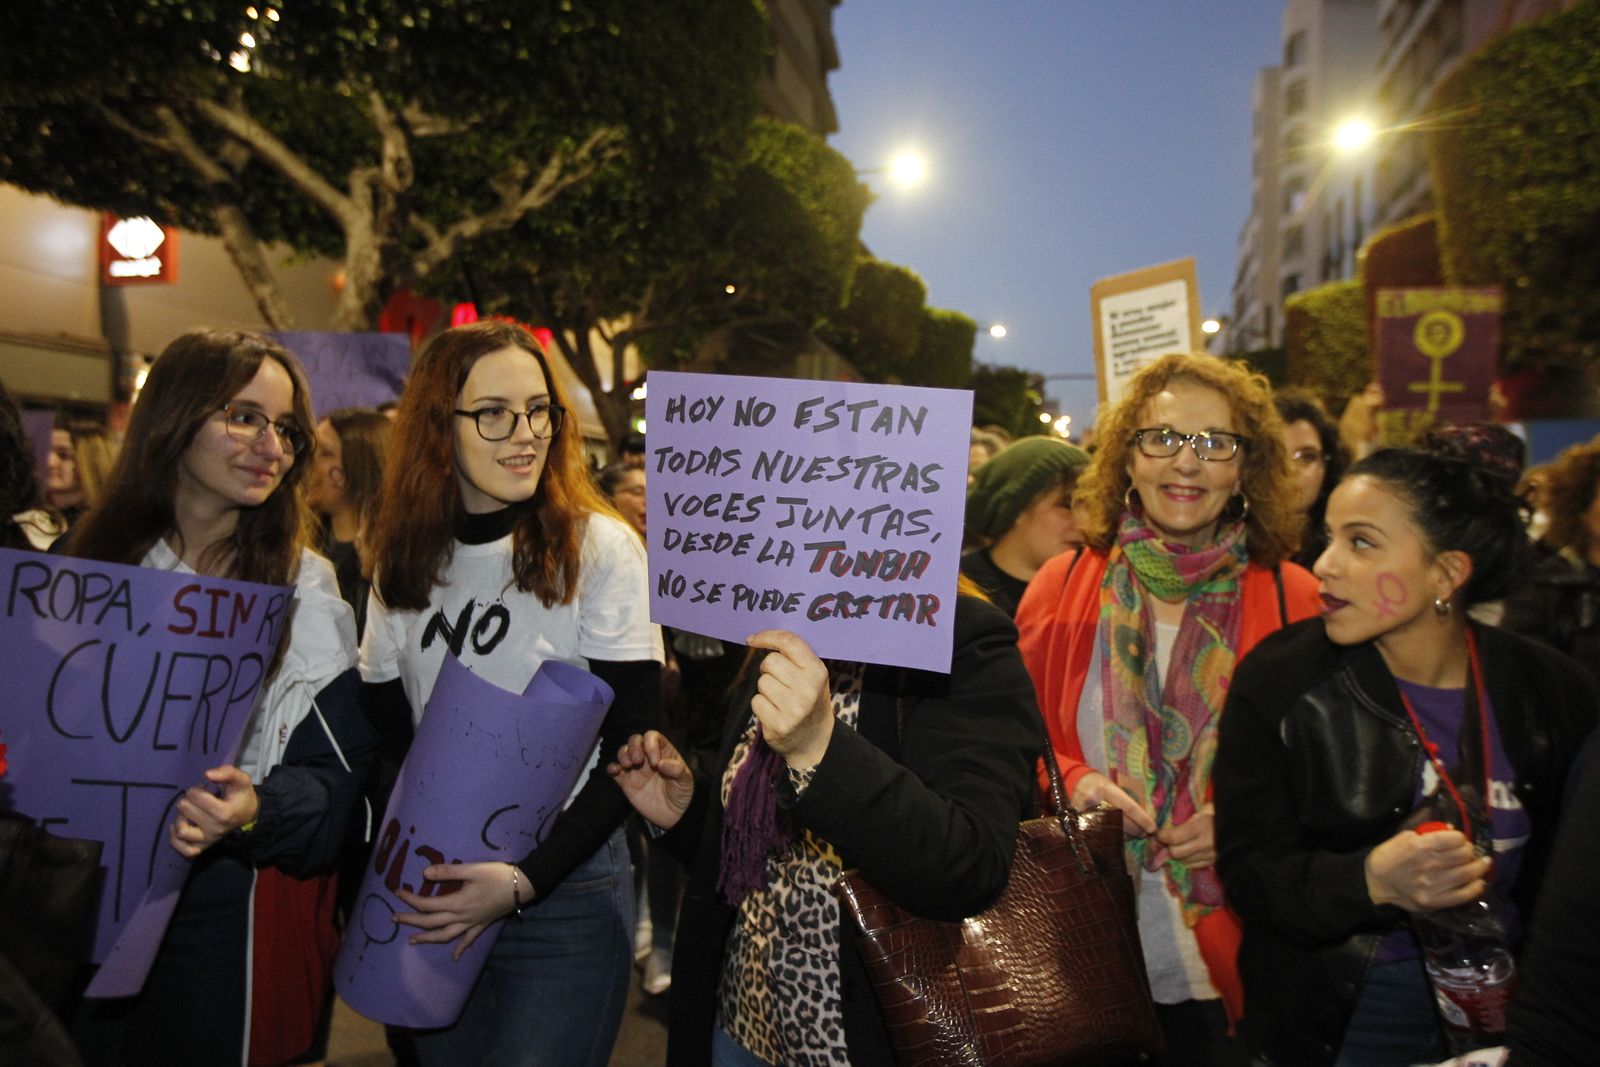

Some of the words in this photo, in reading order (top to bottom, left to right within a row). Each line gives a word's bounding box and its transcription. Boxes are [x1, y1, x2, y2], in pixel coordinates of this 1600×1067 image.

[665, 394, 725, 424] HOY
[733, 396, 776, 427] NO
[793, 396, 928, 437] ESTAN
[654, 446, 743, 477] TODAS
[751, 449, 944, 493] NUESTRAS
[663, 492, 766, 523] VOCES
[775, 496, 942, 544] JUNTAS,
[663, 527, 755, 557] DESDE
[756, 536, 795, 567] LA
[803, 540, 931, 582] TUMBA
[7, 560, 151, 637] ROPA,
[167, 583, 258, 639] SIN
[657, 568, 687, 598] NO
[690, 579, 726, 604] SE
[731, 583, 806, 614] PUEDE
[806, 591, 941, 627] GRITAR
[420, 596, 511, 659] NO
